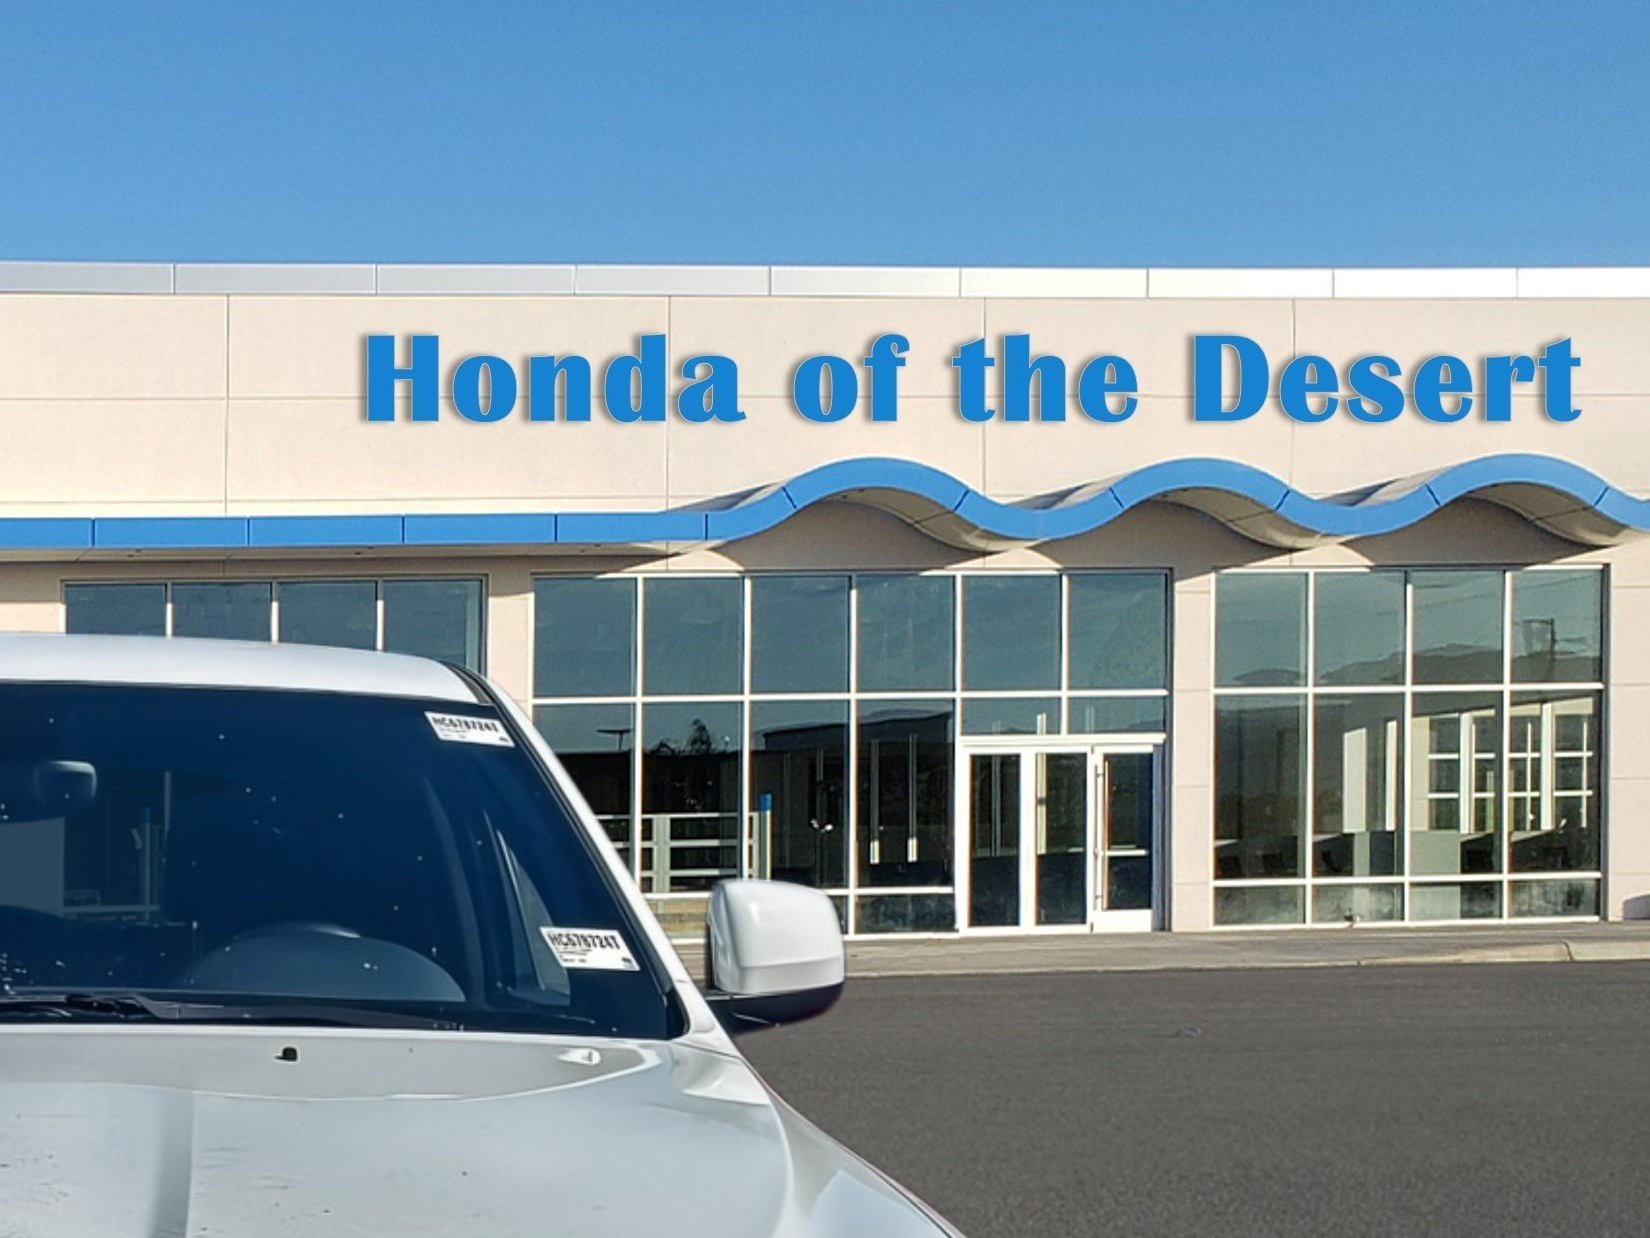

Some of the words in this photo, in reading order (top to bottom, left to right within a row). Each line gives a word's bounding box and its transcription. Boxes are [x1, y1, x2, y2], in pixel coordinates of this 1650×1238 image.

[365, 333, 746, 423] Honda
[793, 333, 910, 424] of
[952, 333, 1138, 424] the
[1193, 334, 1583, 424] Desert
